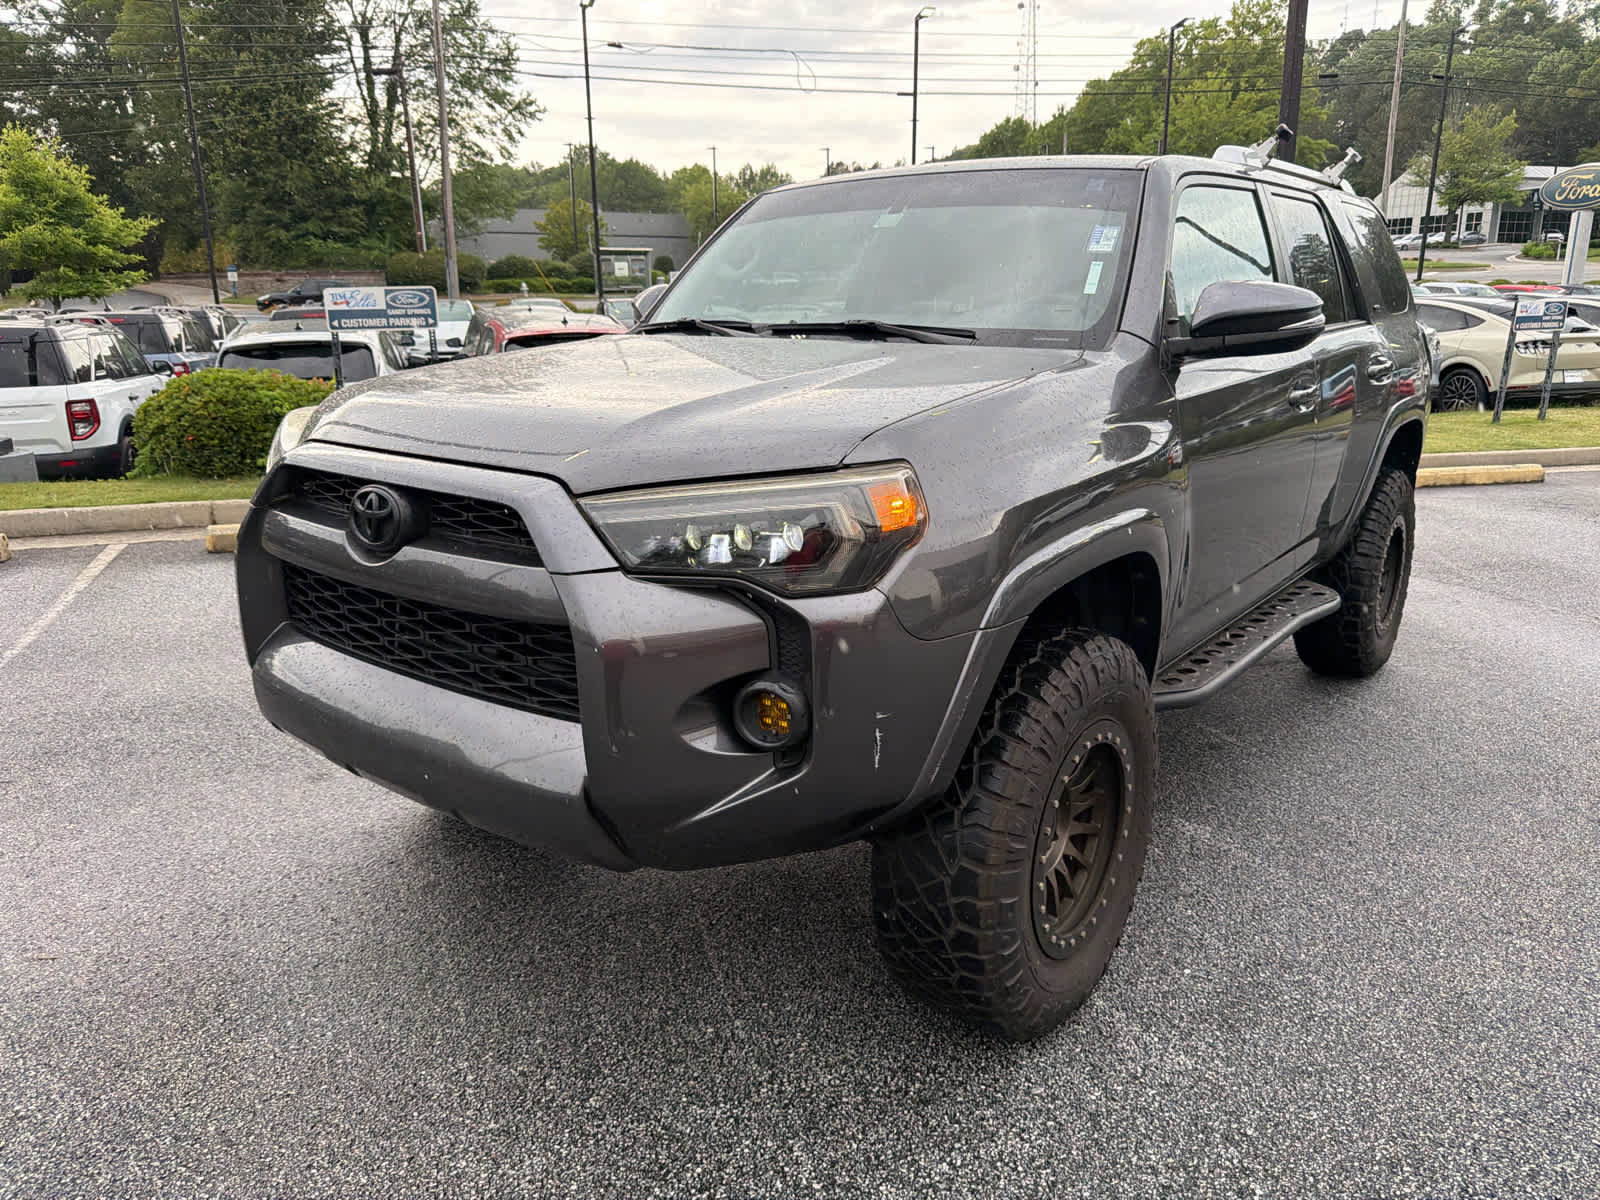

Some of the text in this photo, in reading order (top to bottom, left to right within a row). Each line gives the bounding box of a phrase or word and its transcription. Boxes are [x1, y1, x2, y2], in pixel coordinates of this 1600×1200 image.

[394, 294, 419, 304] Ford
[341, 317, 426, 327] CUSTOMER PARKING
